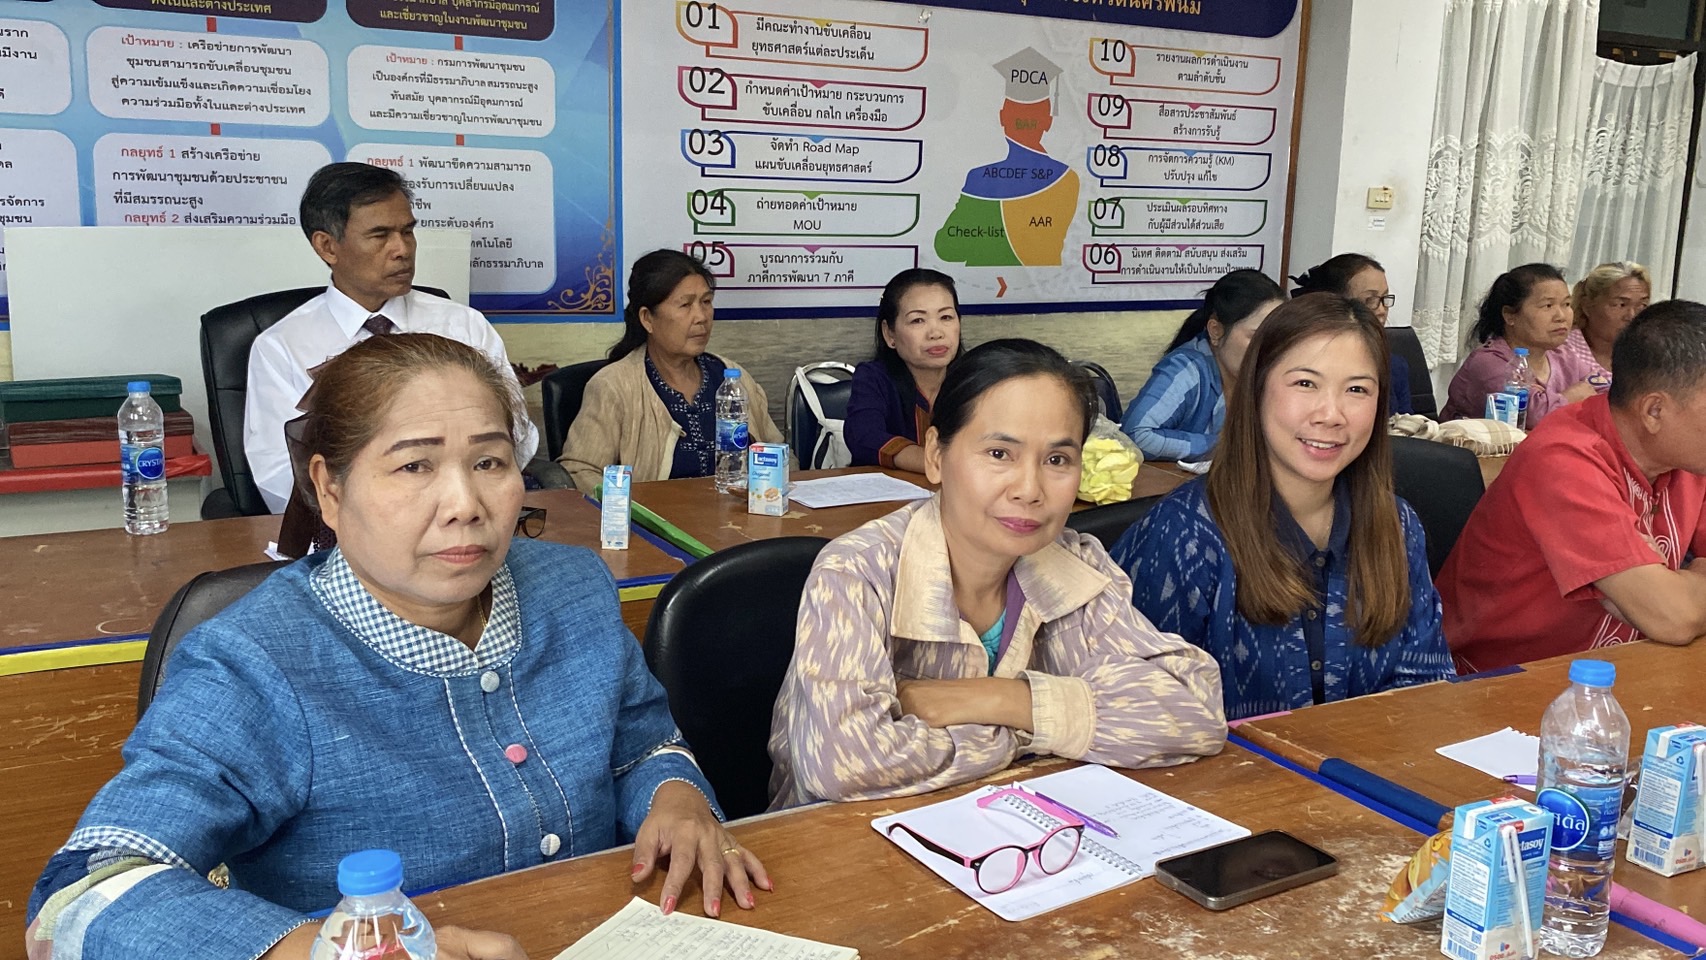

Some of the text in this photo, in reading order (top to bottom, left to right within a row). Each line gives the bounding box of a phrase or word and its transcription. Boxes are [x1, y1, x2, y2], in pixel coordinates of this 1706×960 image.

[685, 1, 720, 29] 01
[757, 17, 872, 41] มีคณะทำงานขับเคลื่อน
[0, 47, 37, 60] มีงาน
[122, 35, 174, 49] เป้าหมาย
[188, 40, 291, 56] เครือข่ายการพัฒนา
[752, 42, 874, 61] ยุทธศาสตร์แต่ละประเด็น
[1100, 39, 1126, 62] 10
[126, 58, 291, 77] ชุมชนสามารถขับเคลื่อนชุมชน
[386, 53, 427, 65] เป้าหมาย
[438, 59, 525, 74] กรมการพัฒนาชุมชน
[1157, 54, 1248, 69] รายงานผลการดำเนินงาน
[688, 66, 725, 94] 02
[1011, 70, 1048, 85] PDCA
[1178, 69, 1225, 84] ตามลำดับชั้น
[111, 75, 311, 96] สู่ความเข้มแข็งและเกิดความเชื่อมโยง
[746, 80, 904, 104] กำหนดค่าเป้าหมาย กระบวนการ
[390, 90, 424, 103] ทันสมัย
[1099, 94, 1124, 116] 09
[122, 97, 305, 114] ความร่วมมือทั้งในและต่างประเทศ
[763, 101, 887, 123] ขับเคลื่อน กลไก เครื่องมือ
[1159, 104, 1237, 121] สื่อสารประชาสัมพันธ์
[370, 109, 542, 129] และมีความเชี่ยวชาญในการพัฒนาชุมชน
[1174, 123, 1221, 143] สร้างการรับรู้
[688, 129, 724, 155] 03
[771, 137, 859, 157] จัดทำ Road Map
[121, 146, 260, 162] กลยุทธ์ 1 สร้างเครือข่าย
[1094, 144, 1120, 167] 08
[1149, 152, 1234, 169] การจัดการความรู้ (KM)
[408, 159, 413, 167] 1
[419, 156, 531, 172] พัฒนาขีดความสามารถ
[755, 158, 872, 177] แผนขับเคลื่อนยุทธศาสตร์
[113, 169, 287, 187] การพัฒนาชุมชนด้วยประชาชน
[983, 167, 1053, 180] ABCDEF S&P
[1164, 169, 1217, 185] ปรับปรุง แก้ไข
[113, 189, 203, 210] ที่มีสมรรถนะสูง
[691, 190, 727, 215] 04
[757, 197, 857, 212] ถ่ายทอดค่าเป้าหมาย
[1094, 198, 1121, 219] 07
[1147, 202, 1227, 215] ประเมินผลรอบทิศทาง
[125, 211, 296, 227] กลยุทธ์ 2 ส่งเสริมความร่วมมือ
[420, 217, 494, 229] ยกระดับองค์กร
[794, 220, 821, 230] MOU
[1029, 216, 1052, 227] AAR
[1148, 218, 1224, 234] กับผู้มีส่วนได้ส่วนเสีย
[947, 225, 1005, 238] Check-list
[691, 241, 725, 266] 05
[760, 251, 843, 269] บูรณาการร่วมกับ
[1090, 243, 1115, 264] 06
[1131, 246, 1247, 262] นิเทศ ติดตาม สนับสนุน ส่งเสริม
[470, 257, 544, 270] ลักธรรมาภิบาล
[1121, 263, 1255, 276] การดำเนินงานให้เป็นไปตามเป้า
[747, 270, 854, 283] ภาคีการพัฒนา 7 ภาคี
[139, 458, 163, 467] CRYST
[1520, 839, 1544, 851] tasoy
